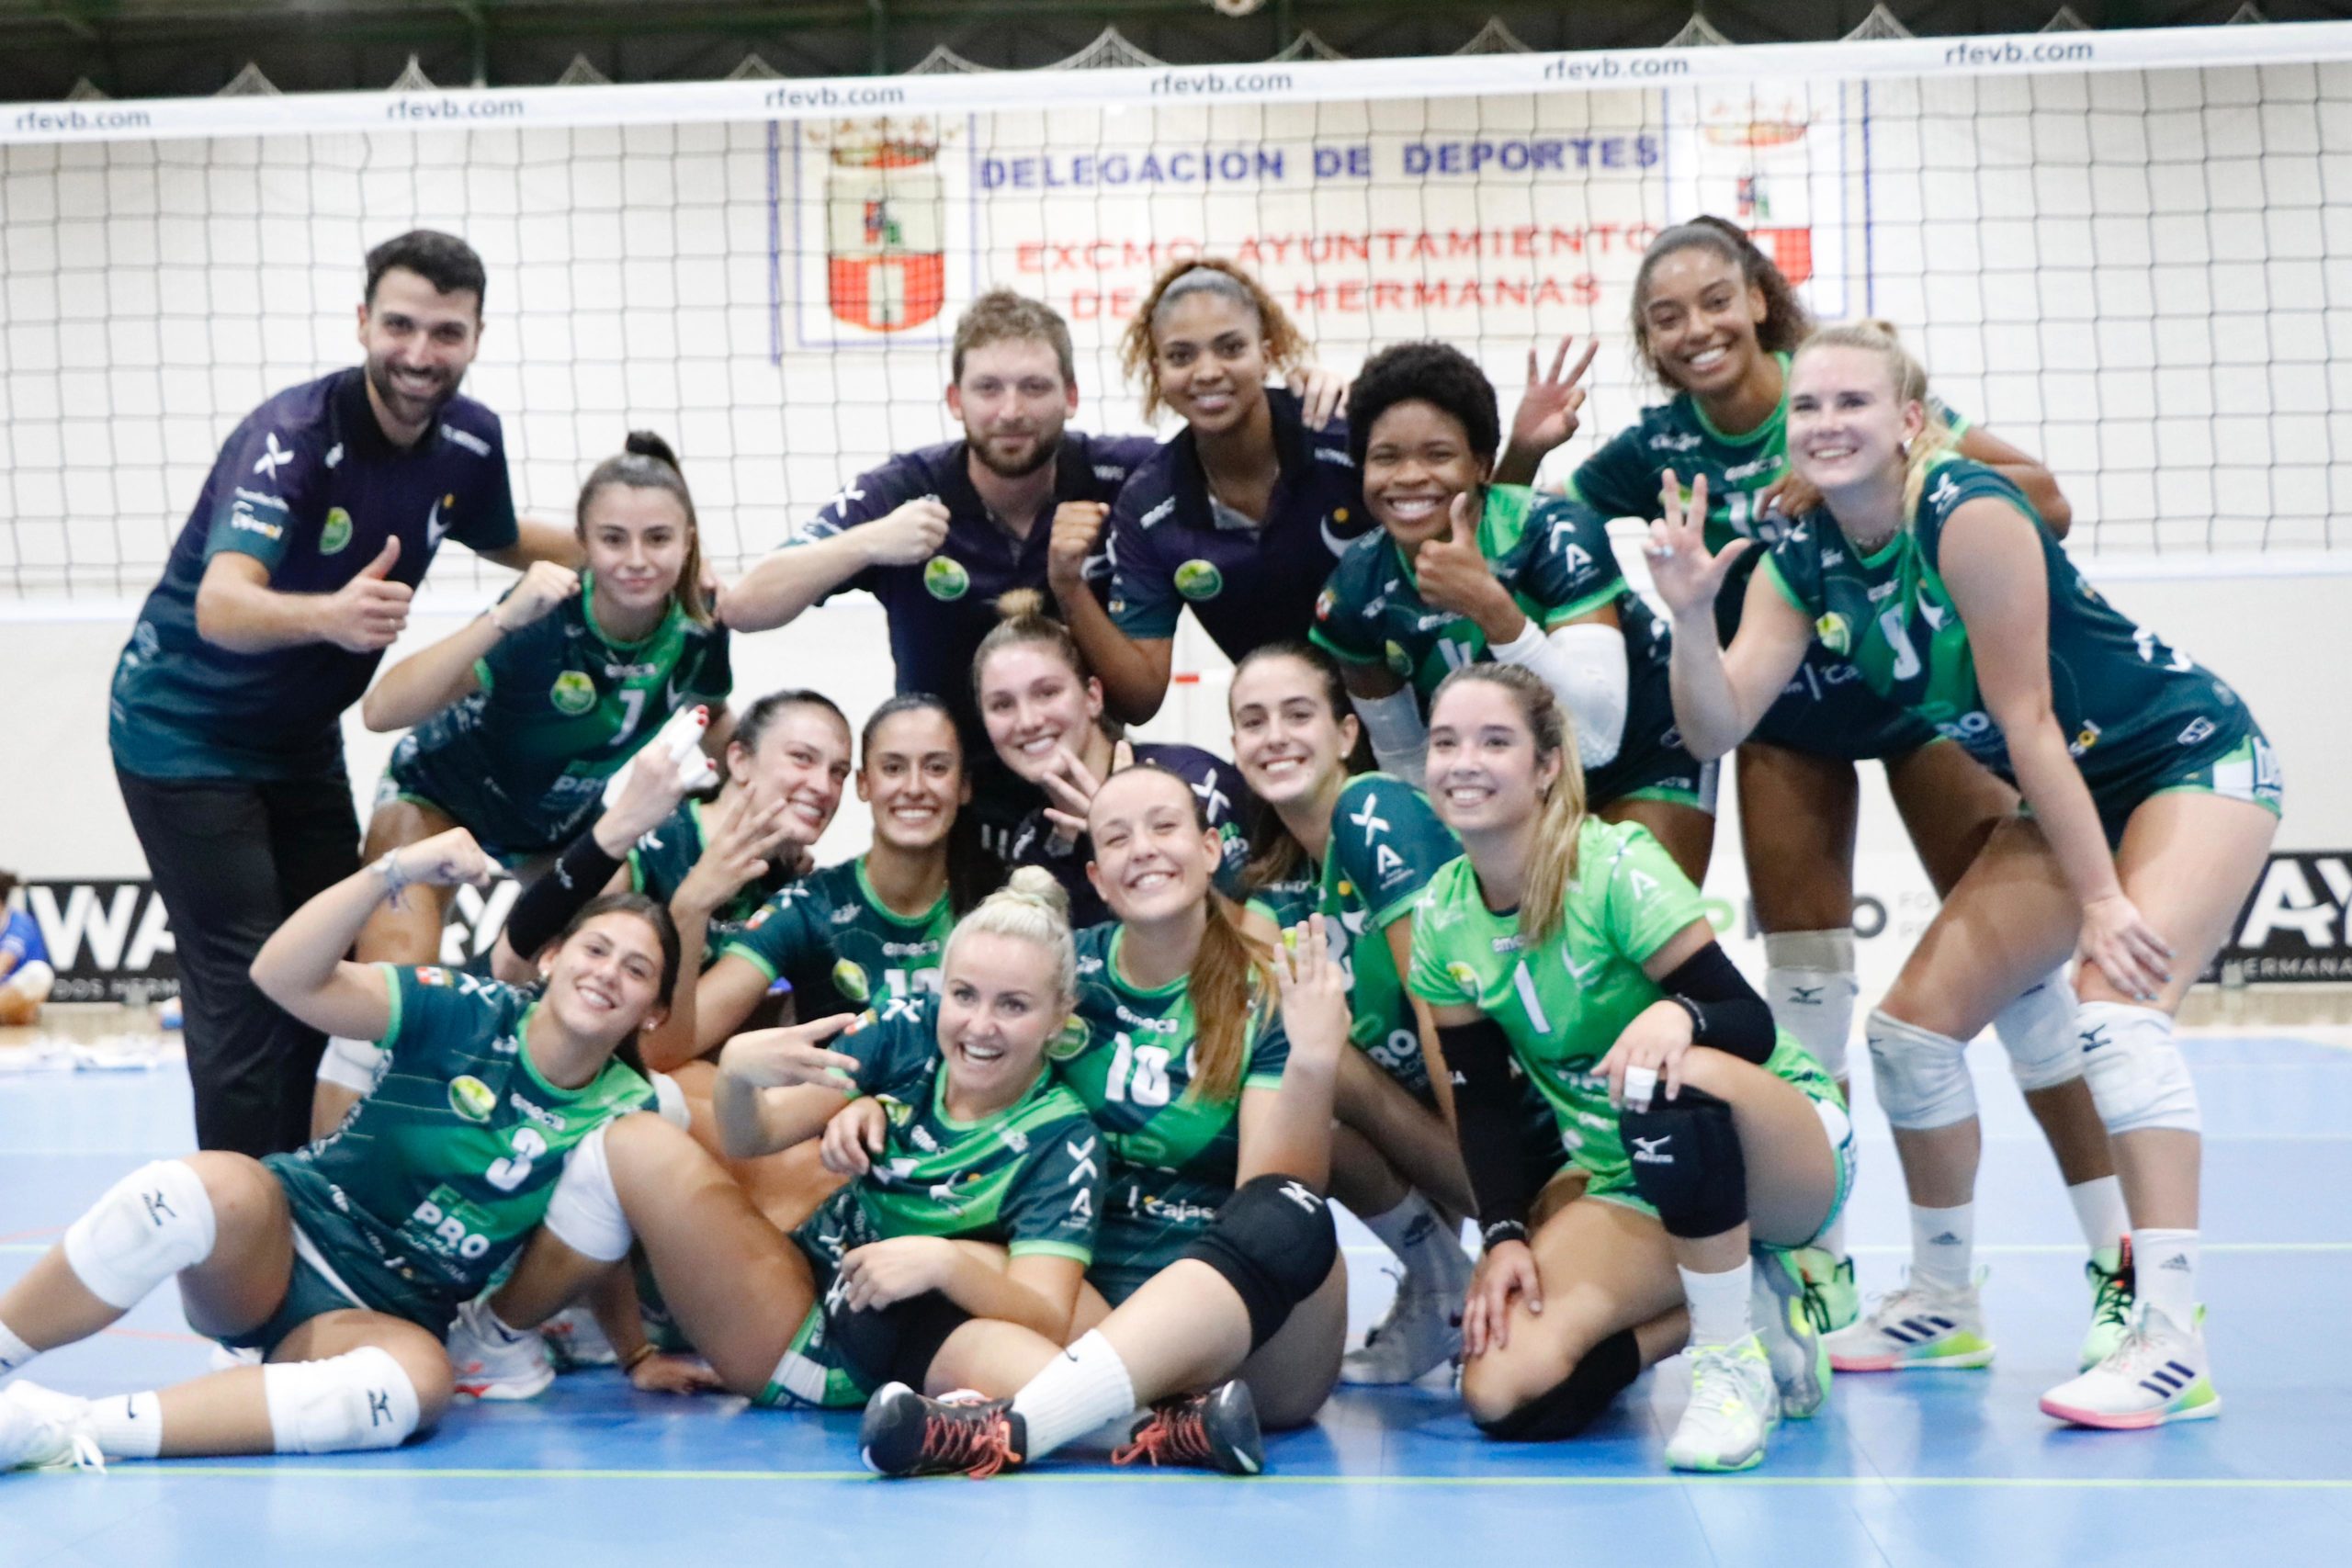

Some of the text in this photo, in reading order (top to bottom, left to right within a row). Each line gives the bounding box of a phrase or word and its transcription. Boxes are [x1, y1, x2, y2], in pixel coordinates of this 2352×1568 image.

[1544, 55, 1689, 80] rfevb.com
[1945, 39, 2094, 65] rfevb.com
[765, 83, 905, 108] rfevb.com
[1150, 69, 1293, 96] rfevb.com
[16, 107, 151, 131] rfevb.com
[386, 96, 524, 120] rfevb.com
[1314, 145, 1371, 177] DE
[1403, 137, 1658, 175] DEPORTES
[1238, 222, 1658, 264] AYUNTAMIENTO
[1071, 274, 1600, 319] DE HERMANAS
[1105, 1031, 1171, 1107] 18
[485, 1127, 548, 1192] 3
[412, 1200, 492, 1259] PRO
